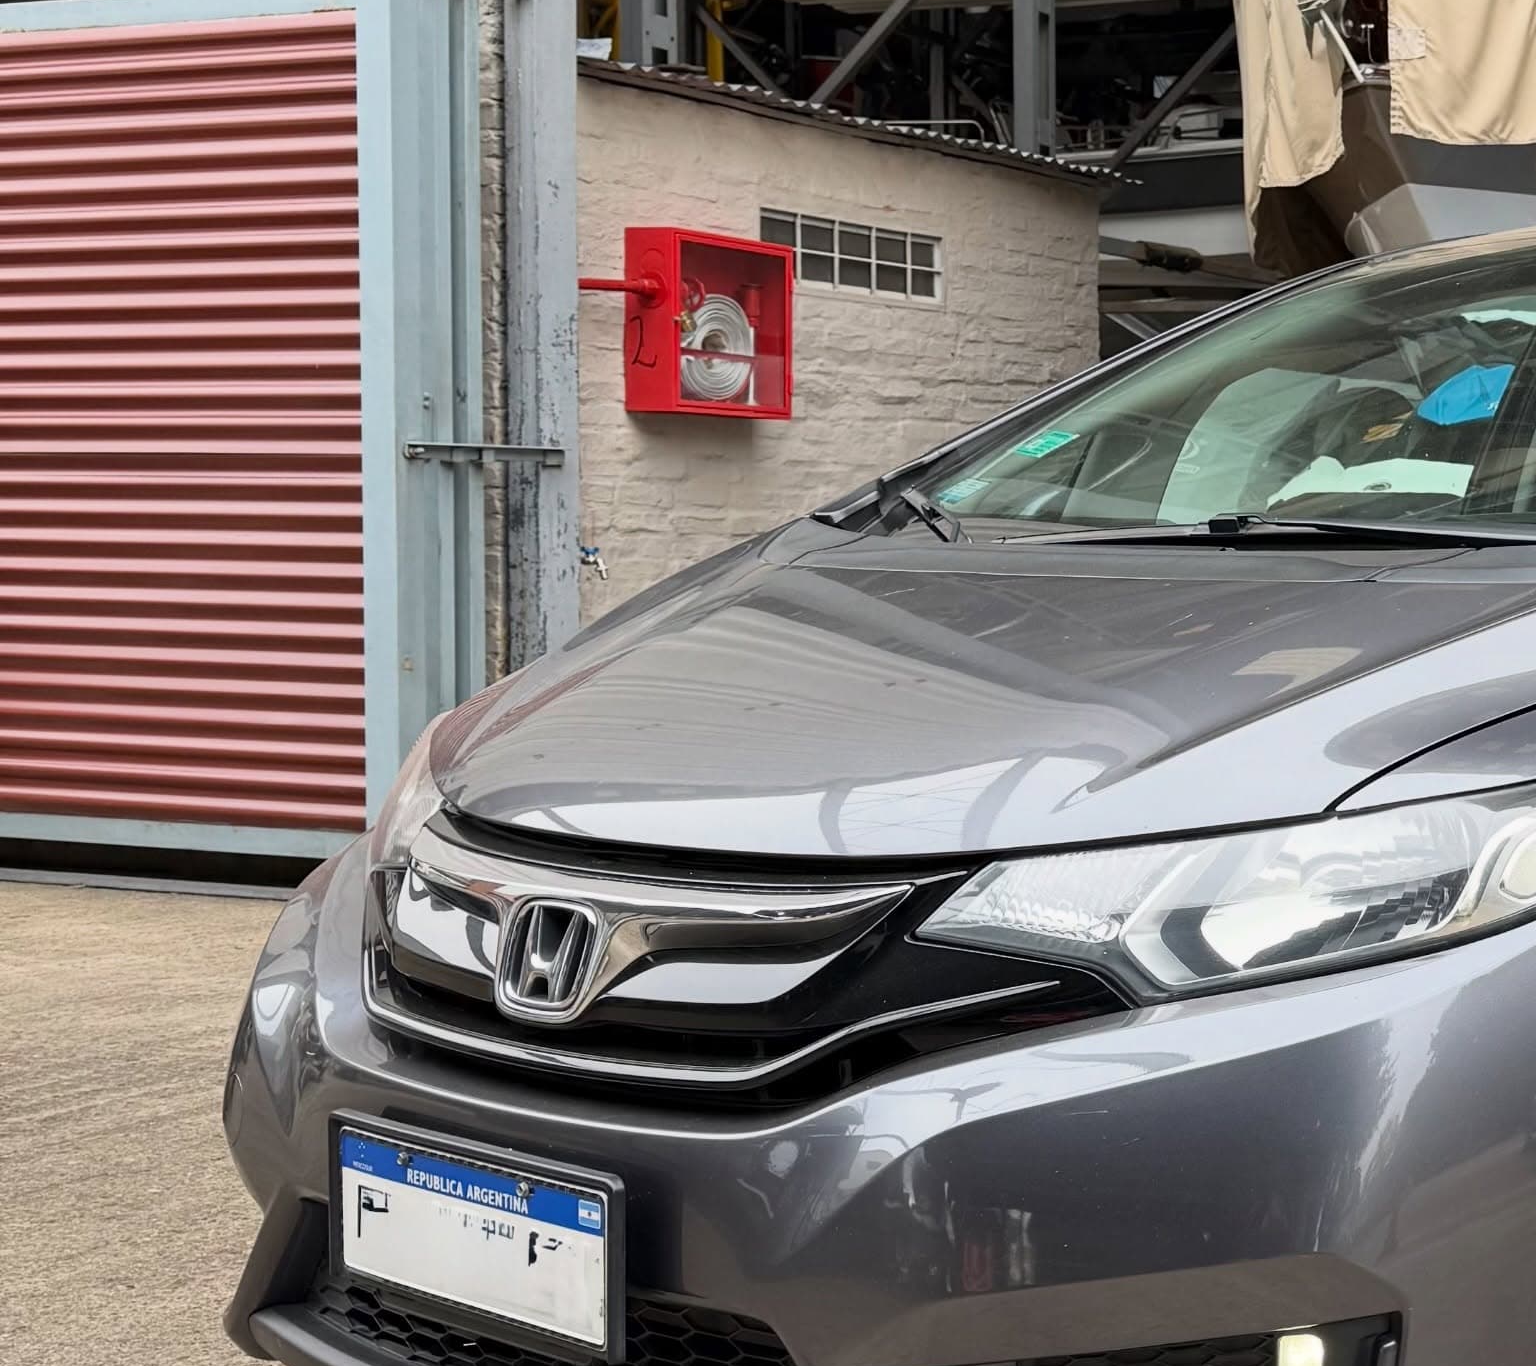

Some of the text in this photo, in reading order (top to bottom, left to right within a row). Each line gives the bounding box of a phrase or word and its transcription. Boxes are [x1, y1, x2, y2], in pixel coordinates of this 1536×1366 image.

[629, 315, 658, 368] 2
[406, 1168, 529, 1215] REPUBLICA ARGENTINA
